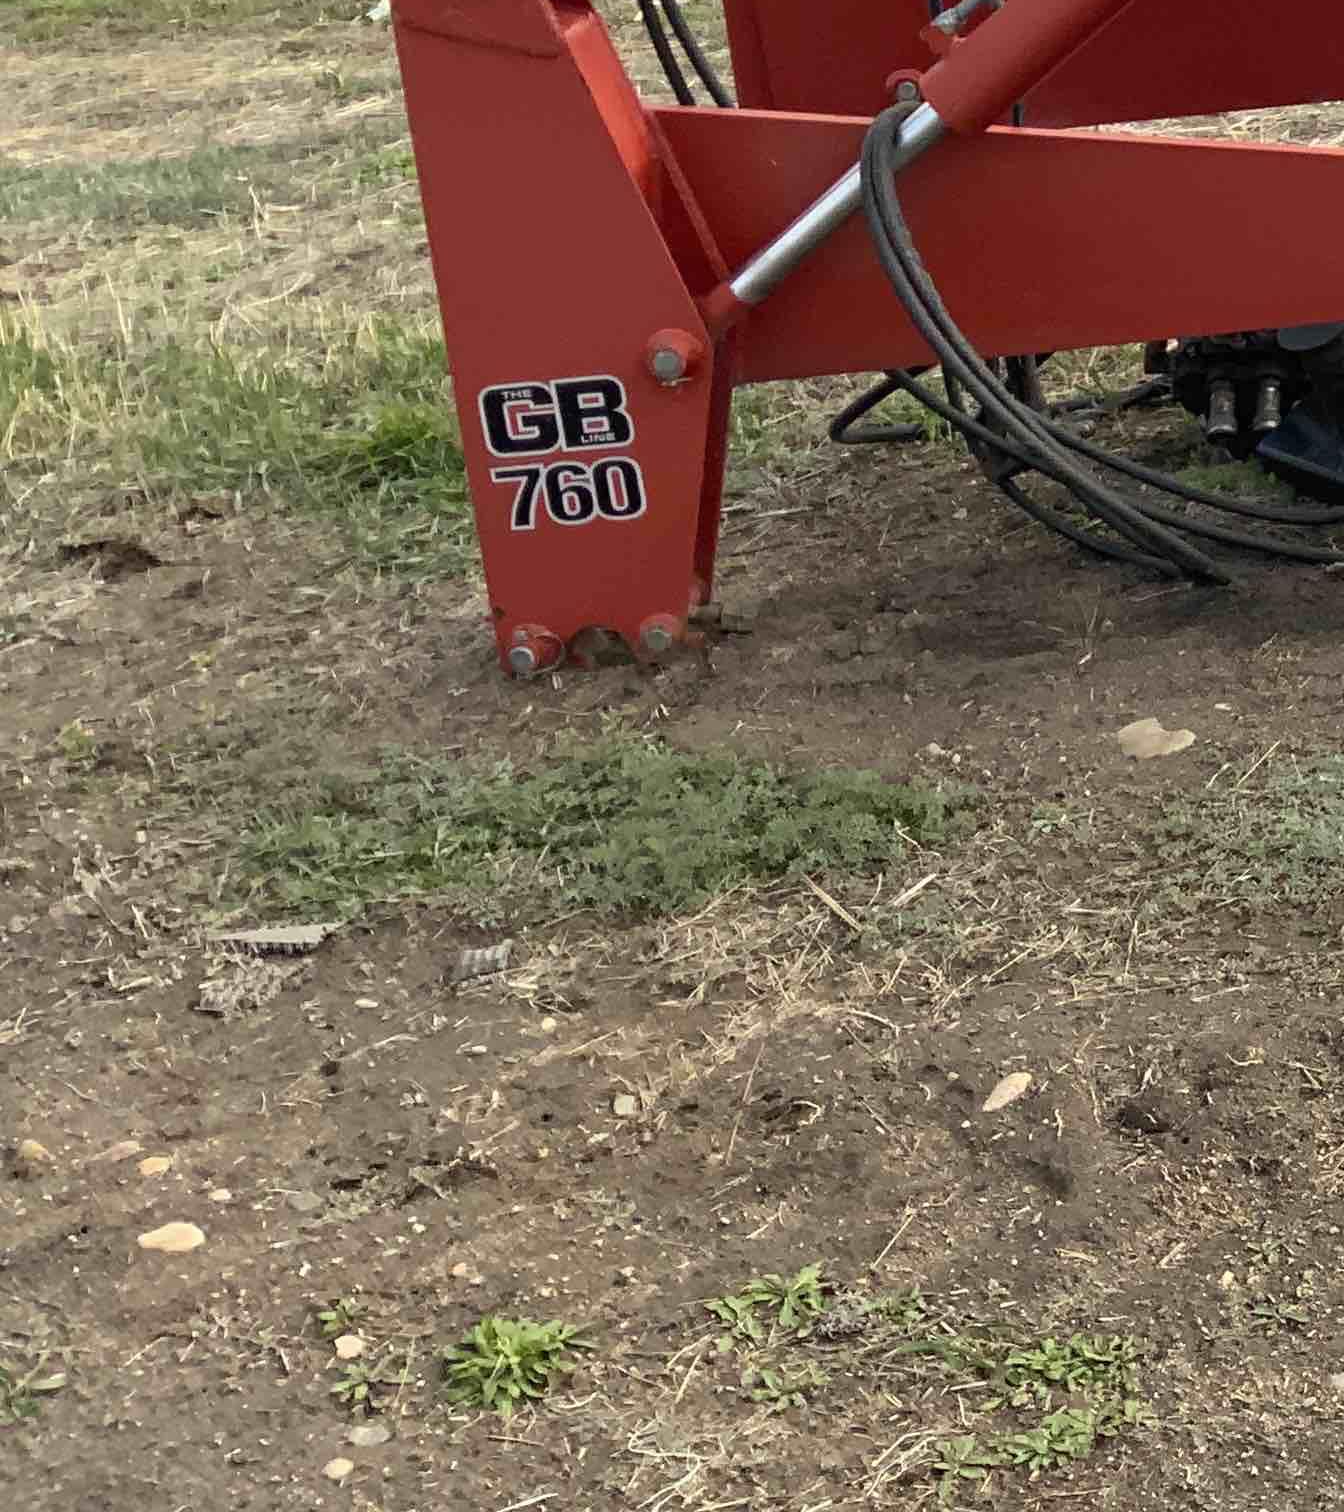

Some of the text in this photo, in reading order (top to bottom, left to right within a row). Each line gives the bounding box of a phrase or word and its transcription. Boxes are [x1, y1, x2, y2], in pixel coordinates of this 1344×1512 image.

[478, 374, 635, 457] GB
[502, 389, 532, 401] THE
[581, 432, 616, 444] LINE
[490, 456, 648, 530] 760
